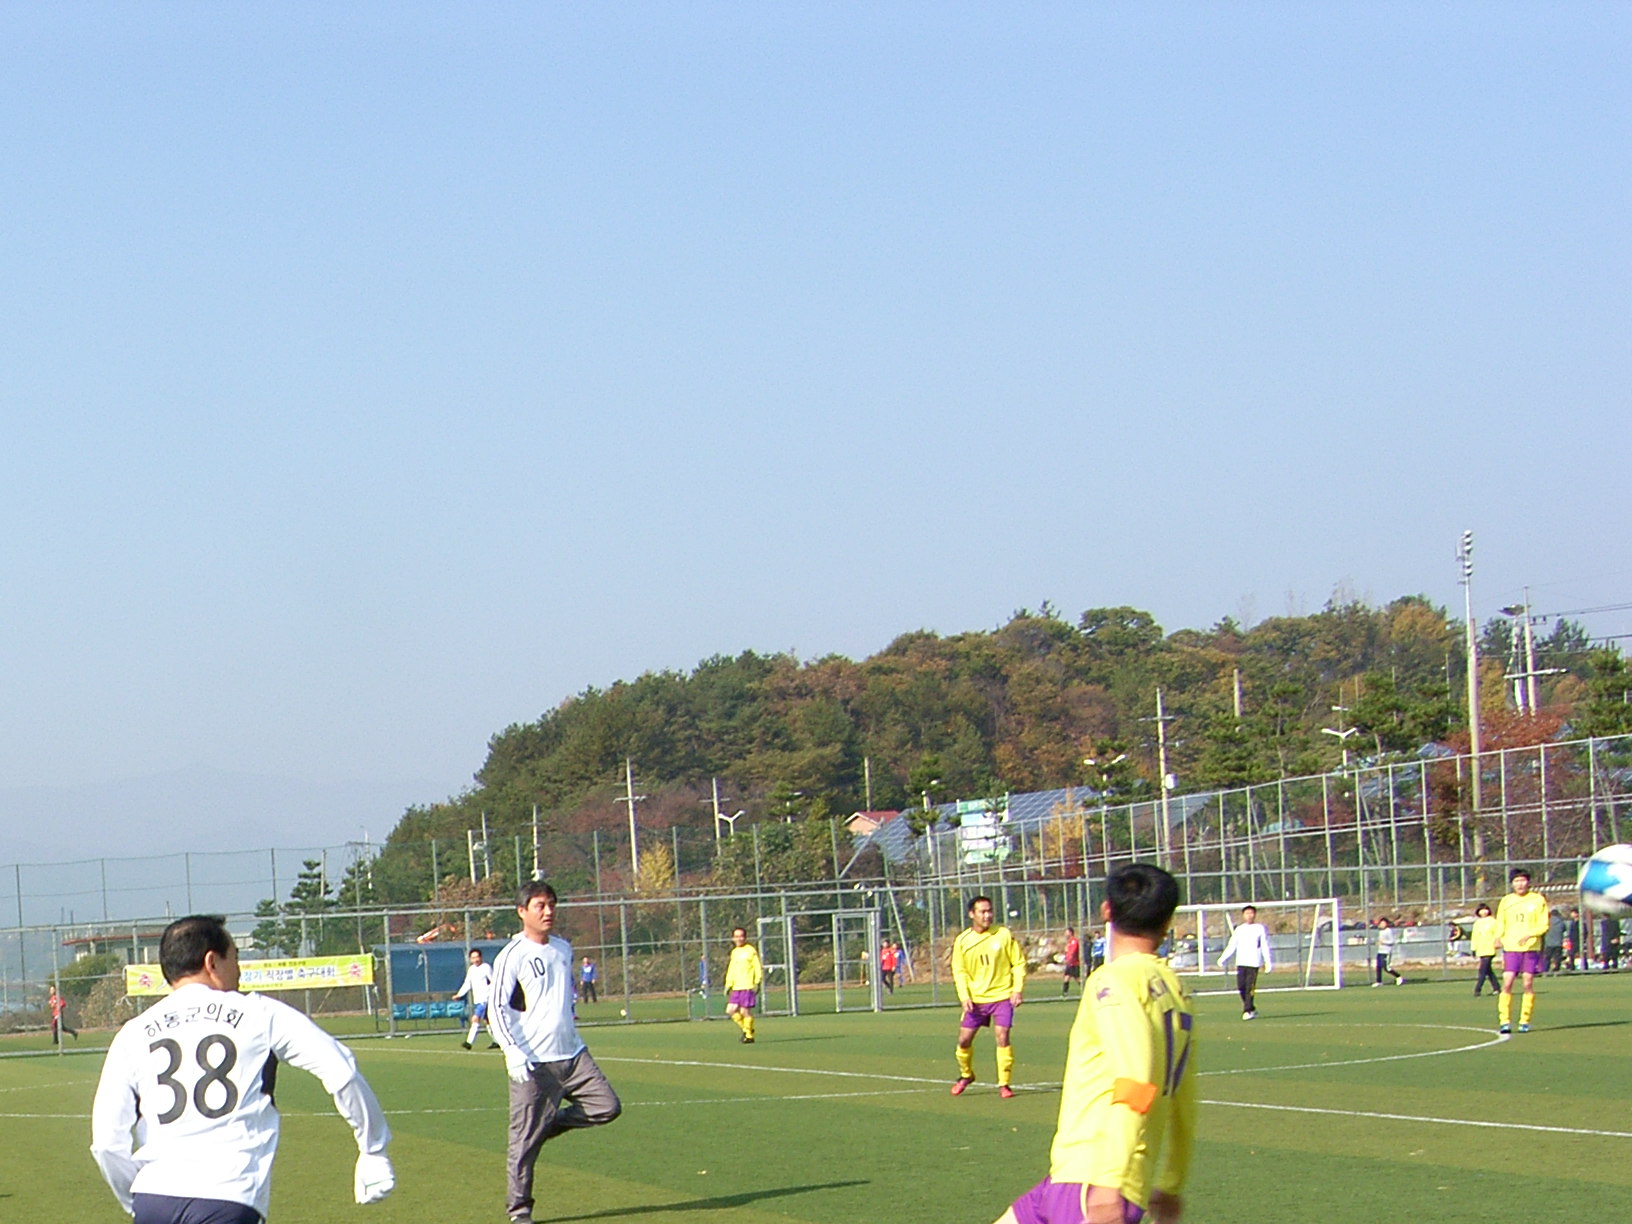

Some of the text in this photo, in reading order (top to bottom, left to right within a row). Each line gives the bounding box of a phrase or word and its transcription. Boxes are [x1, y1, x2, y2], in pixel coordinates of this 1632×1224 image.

[1516, 912, 1525, 923] 12
[528, 957, 546, 978] 10
[979, 953, 990, 966] 11
[297, 965, 336, 979] 축구대회
[144, 1002, 244, 1037] 하동군의회
[1162, 1008, 1193, 1098] 17
[148, 1033, 239, 1125] 38
